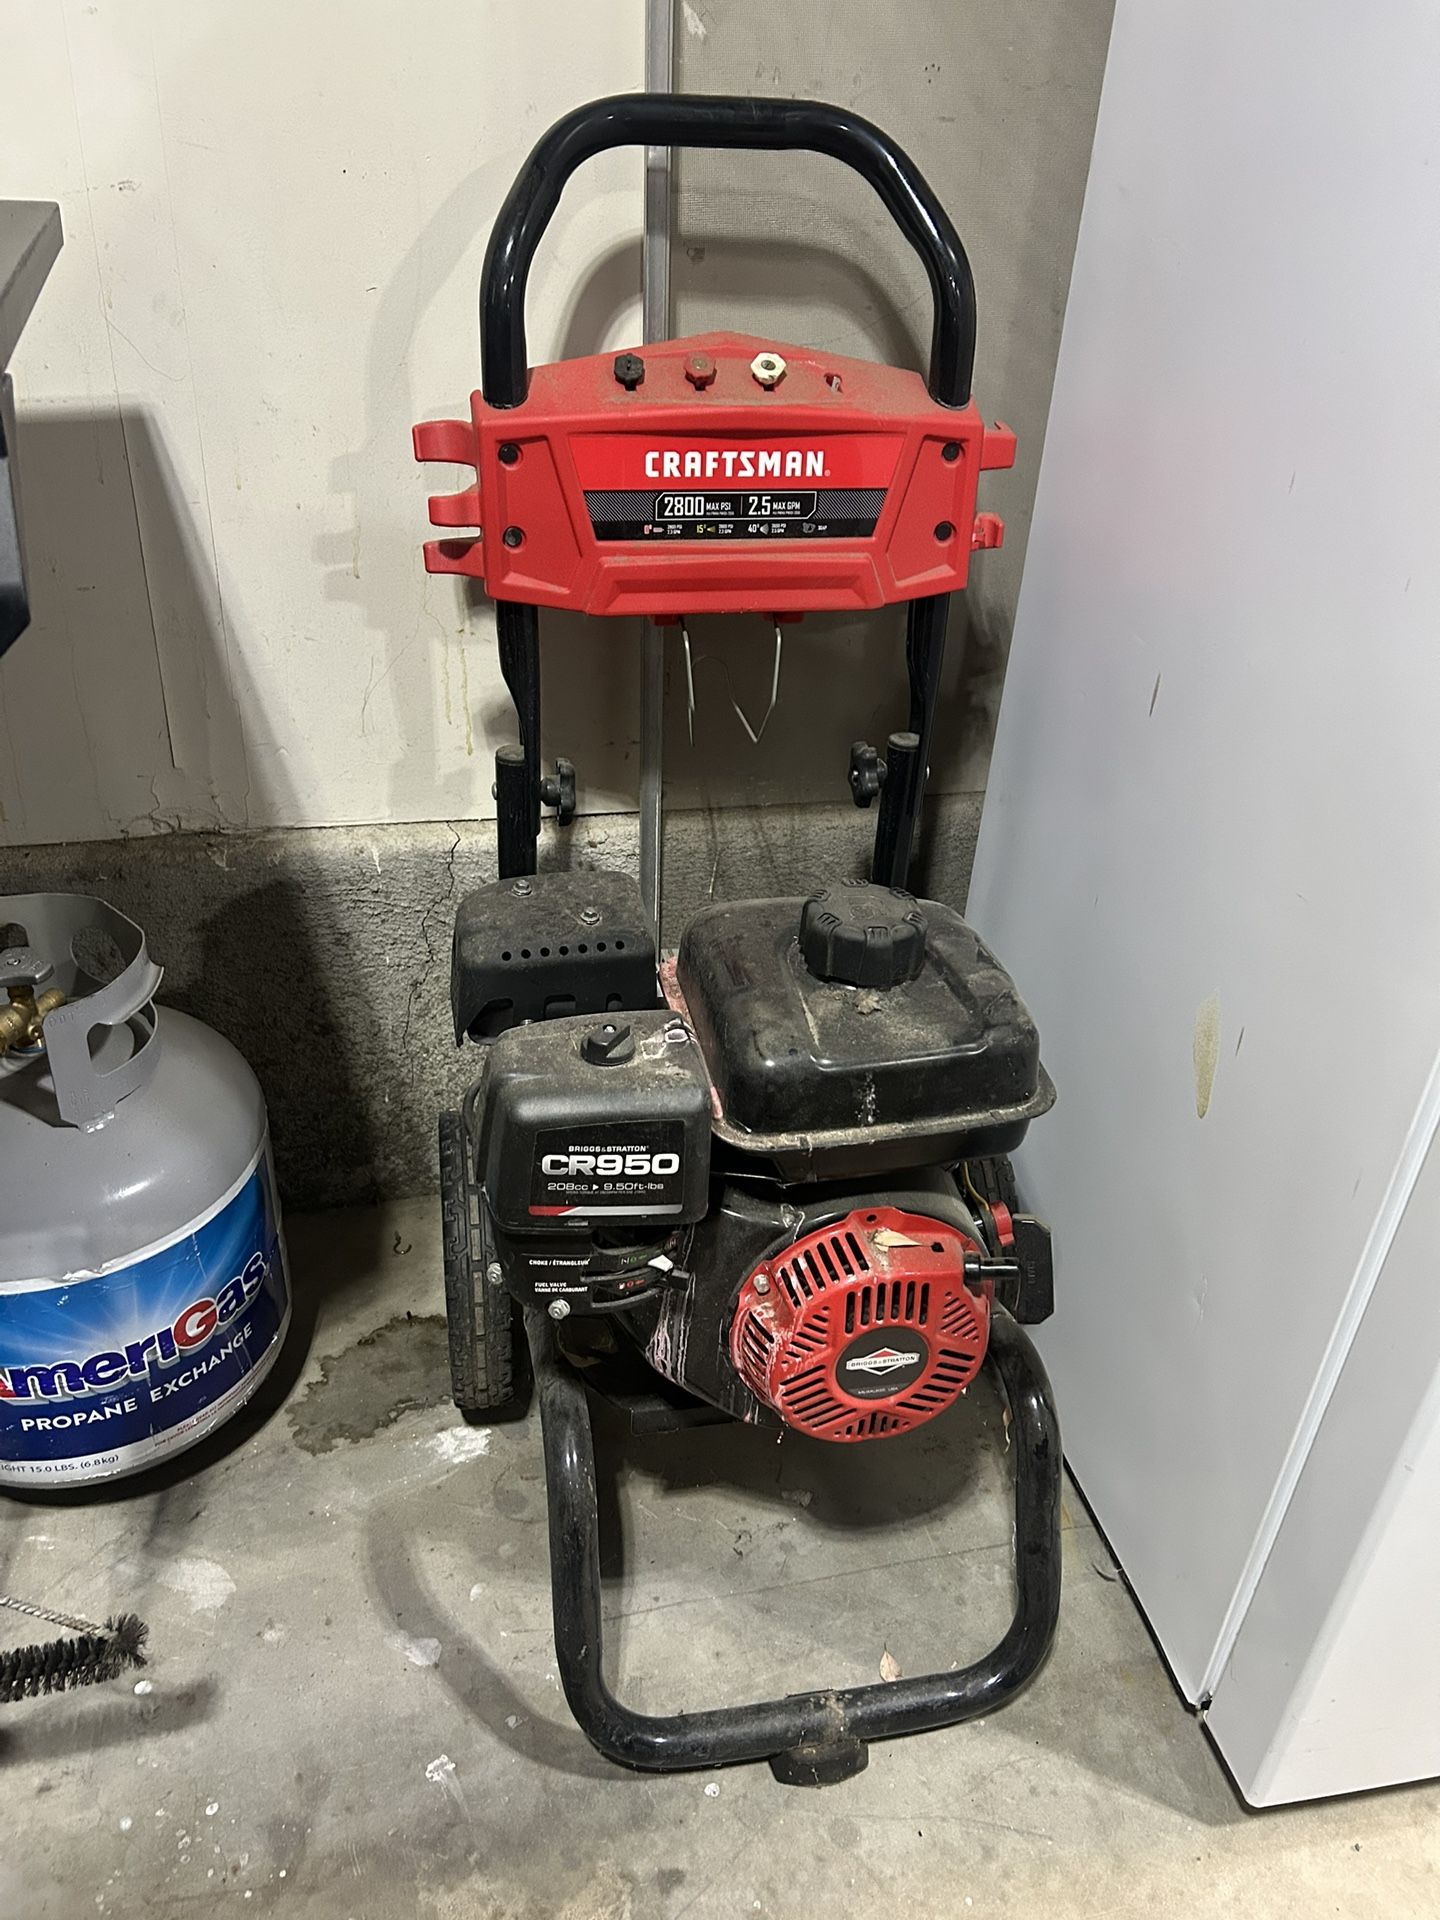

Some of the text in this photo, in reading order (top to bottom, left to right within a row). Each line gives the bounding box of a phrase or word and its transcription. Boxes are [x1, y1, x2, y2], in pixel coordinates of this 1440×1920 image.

[645, 450, 825, 478] CRAFTSMAN
[664, 496, 705, 516] 2800
[706, 502, 719, 511] MAX
[721, 502, 731, 511] PSI
[748, 496, 771, 516] 2.5
[773, 501, 786, 510] MAX
[787, 501, 801, 510] GPM
[541, 1153, 680, 1176] CR950
[547, 1182, 664, 1191] 208cc 9.50ft-lbs
[21, 1397, 138, 1432] PROPANE
[151, 1322, 253, 1403] EXCHANGE
[30, 1465, 52, 1473] 15.0
[55, 1462, 78, 1472] LBS.
